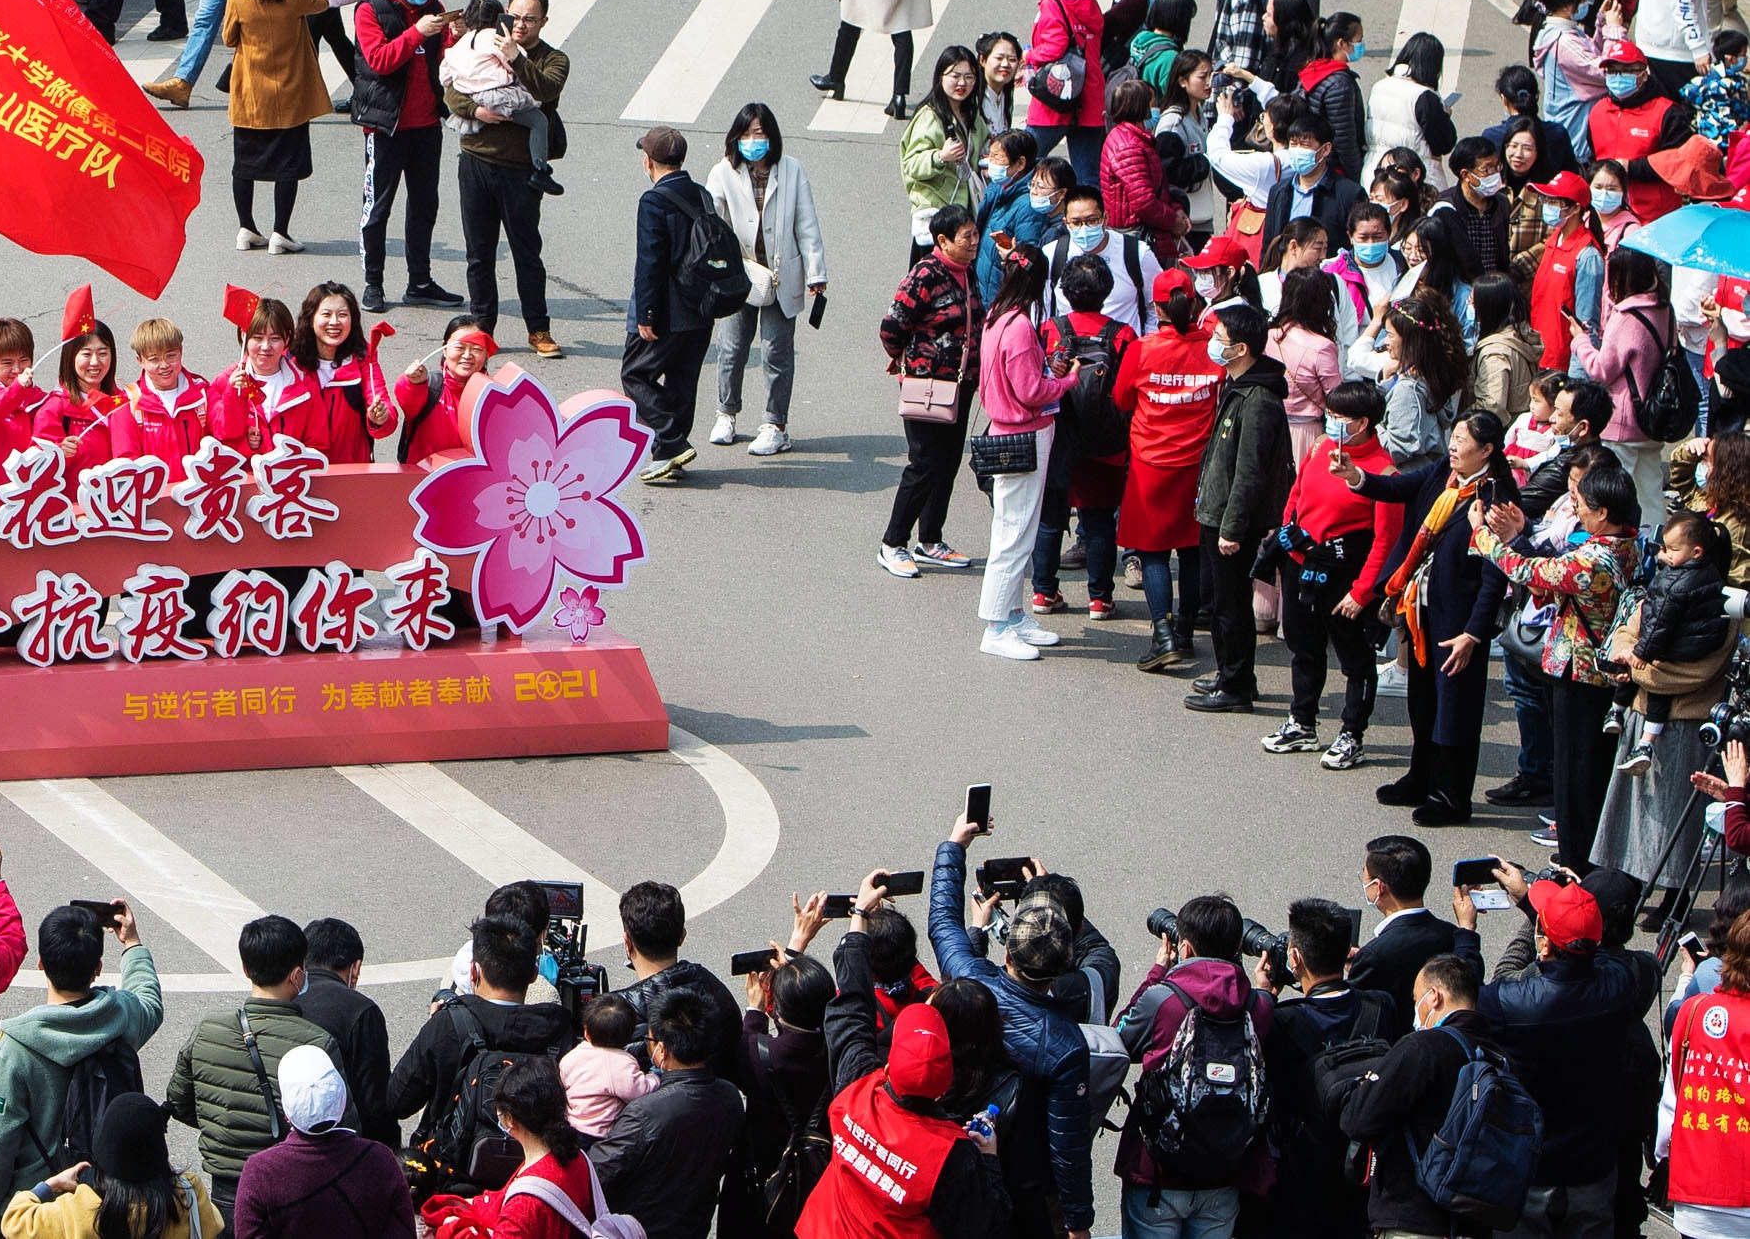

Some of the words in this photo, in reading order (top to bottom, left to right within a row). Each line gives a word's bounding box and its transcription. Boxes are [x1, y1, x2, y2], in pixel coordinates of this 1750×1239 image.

[122, 685, 297, 721] 与逆行者同行
[321, 674, 492, 712] 为奉献者奉献
[513, 668, 598, 702] 2021
[842, 1113, 918, 1180] 与逆行者同行
